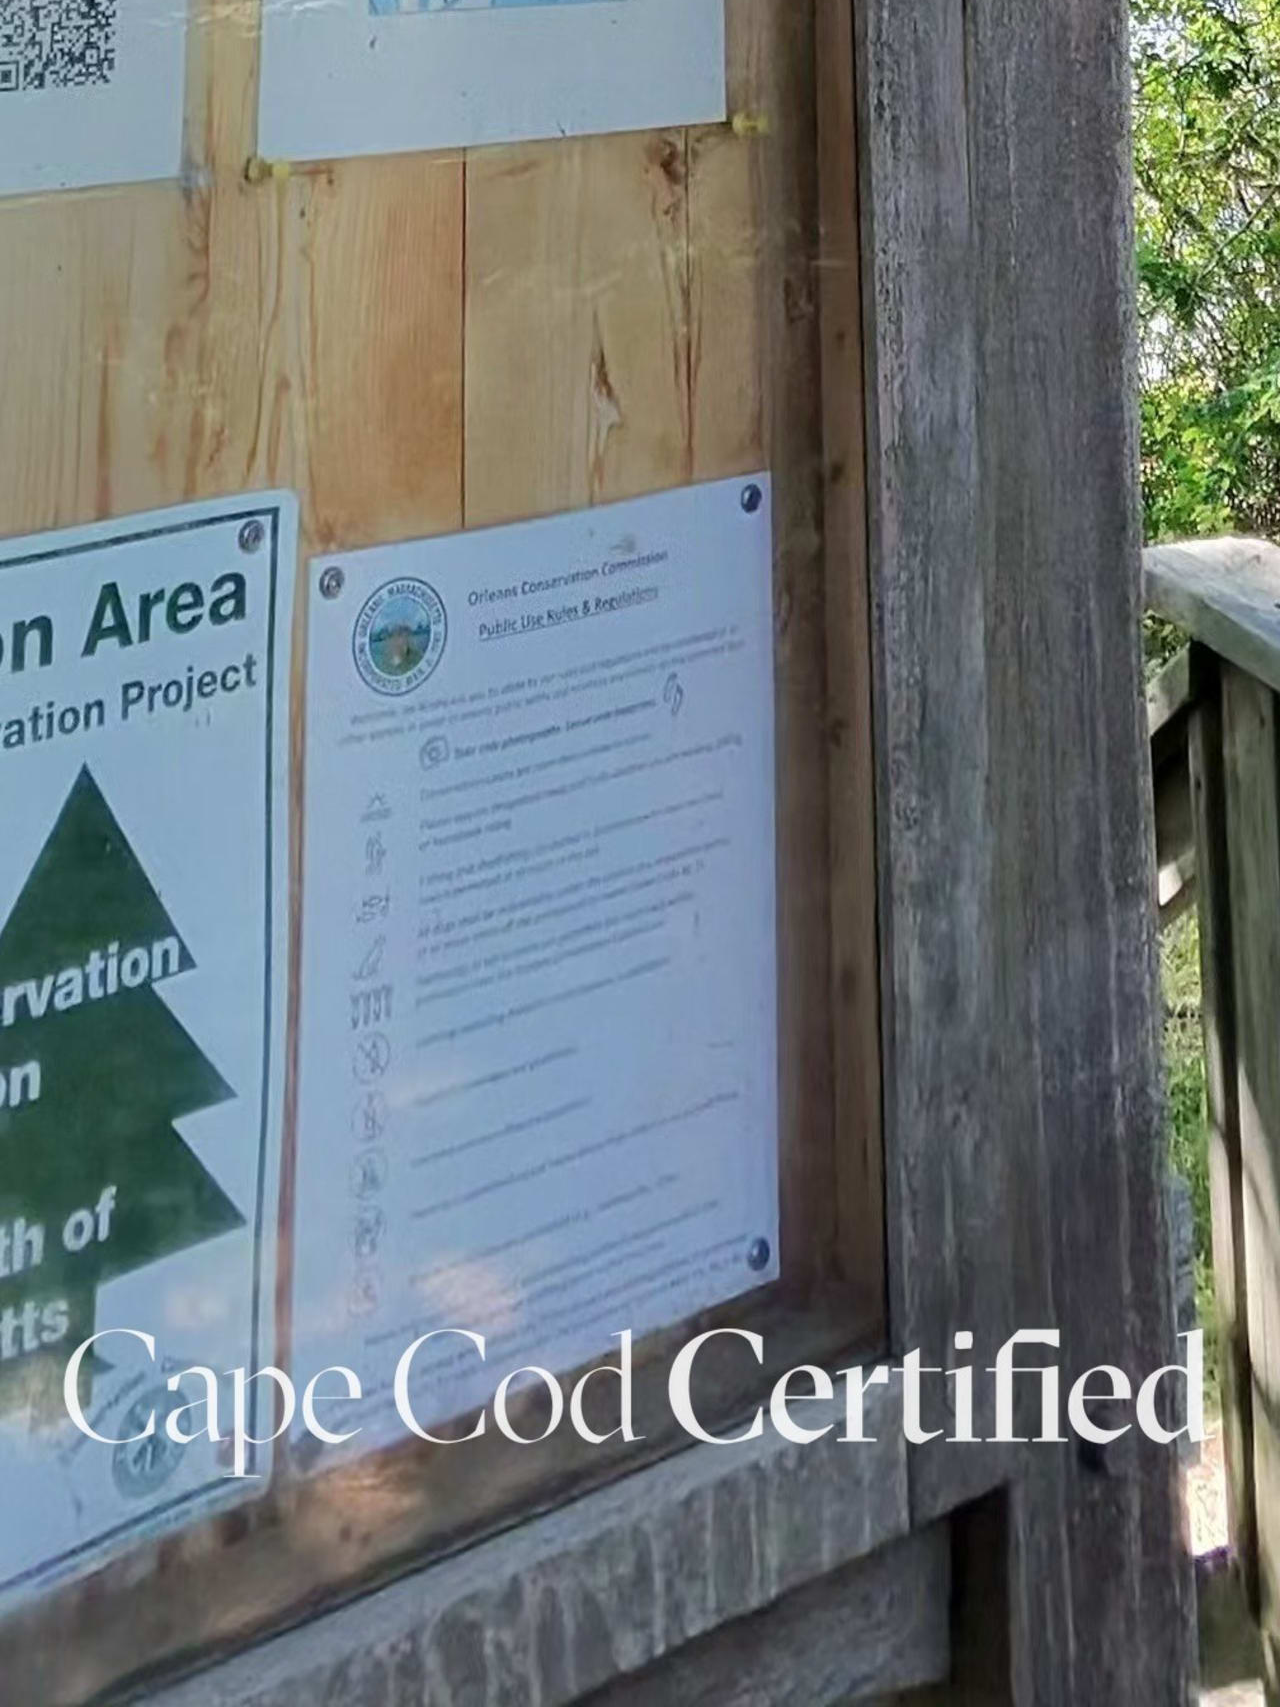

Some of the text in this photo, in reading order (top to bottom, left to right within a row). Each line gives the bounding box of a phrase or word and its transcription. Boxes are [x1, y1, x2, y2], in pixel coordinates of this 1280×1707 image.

[80, 568, 250, 660] Area
[467, 550, 669, 606] Orleans Conservation Commission
[478, 618, 517, 637] Public
[521, 611, 545, 630] Use
[546, 604, 579, 624] Rules
[581, 599, 591, 616] &
[120, 650, 260, 730] Project
[62, 1182, 119, 1254] of
